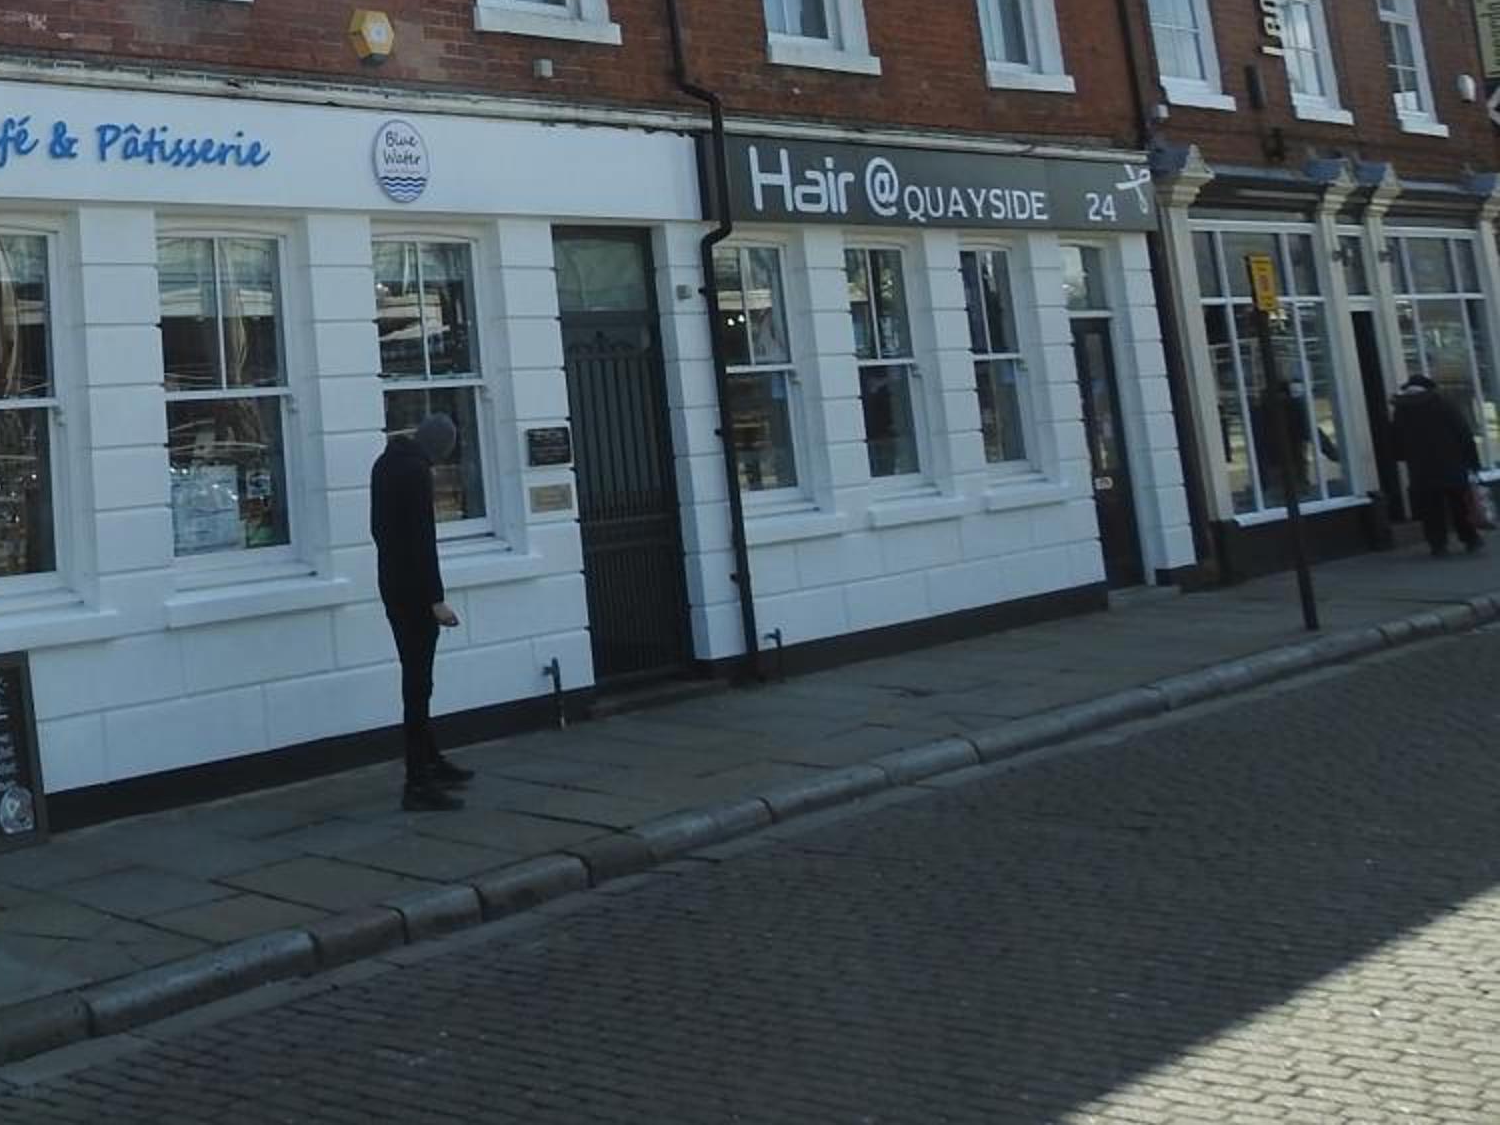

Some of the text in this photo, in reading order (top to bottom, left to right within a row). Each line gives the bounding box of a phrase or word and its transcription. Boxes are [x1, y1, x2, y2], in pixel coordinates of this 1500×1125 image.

[48, 120, 79, 159] &
[96, 122, 271, 168] Pâtisserie
[385, 130, 419, 148] Blue
[382, 148, 421, 166] Water
[748, 144, 1117, 222] Hair @ QUAYSIDE 24
